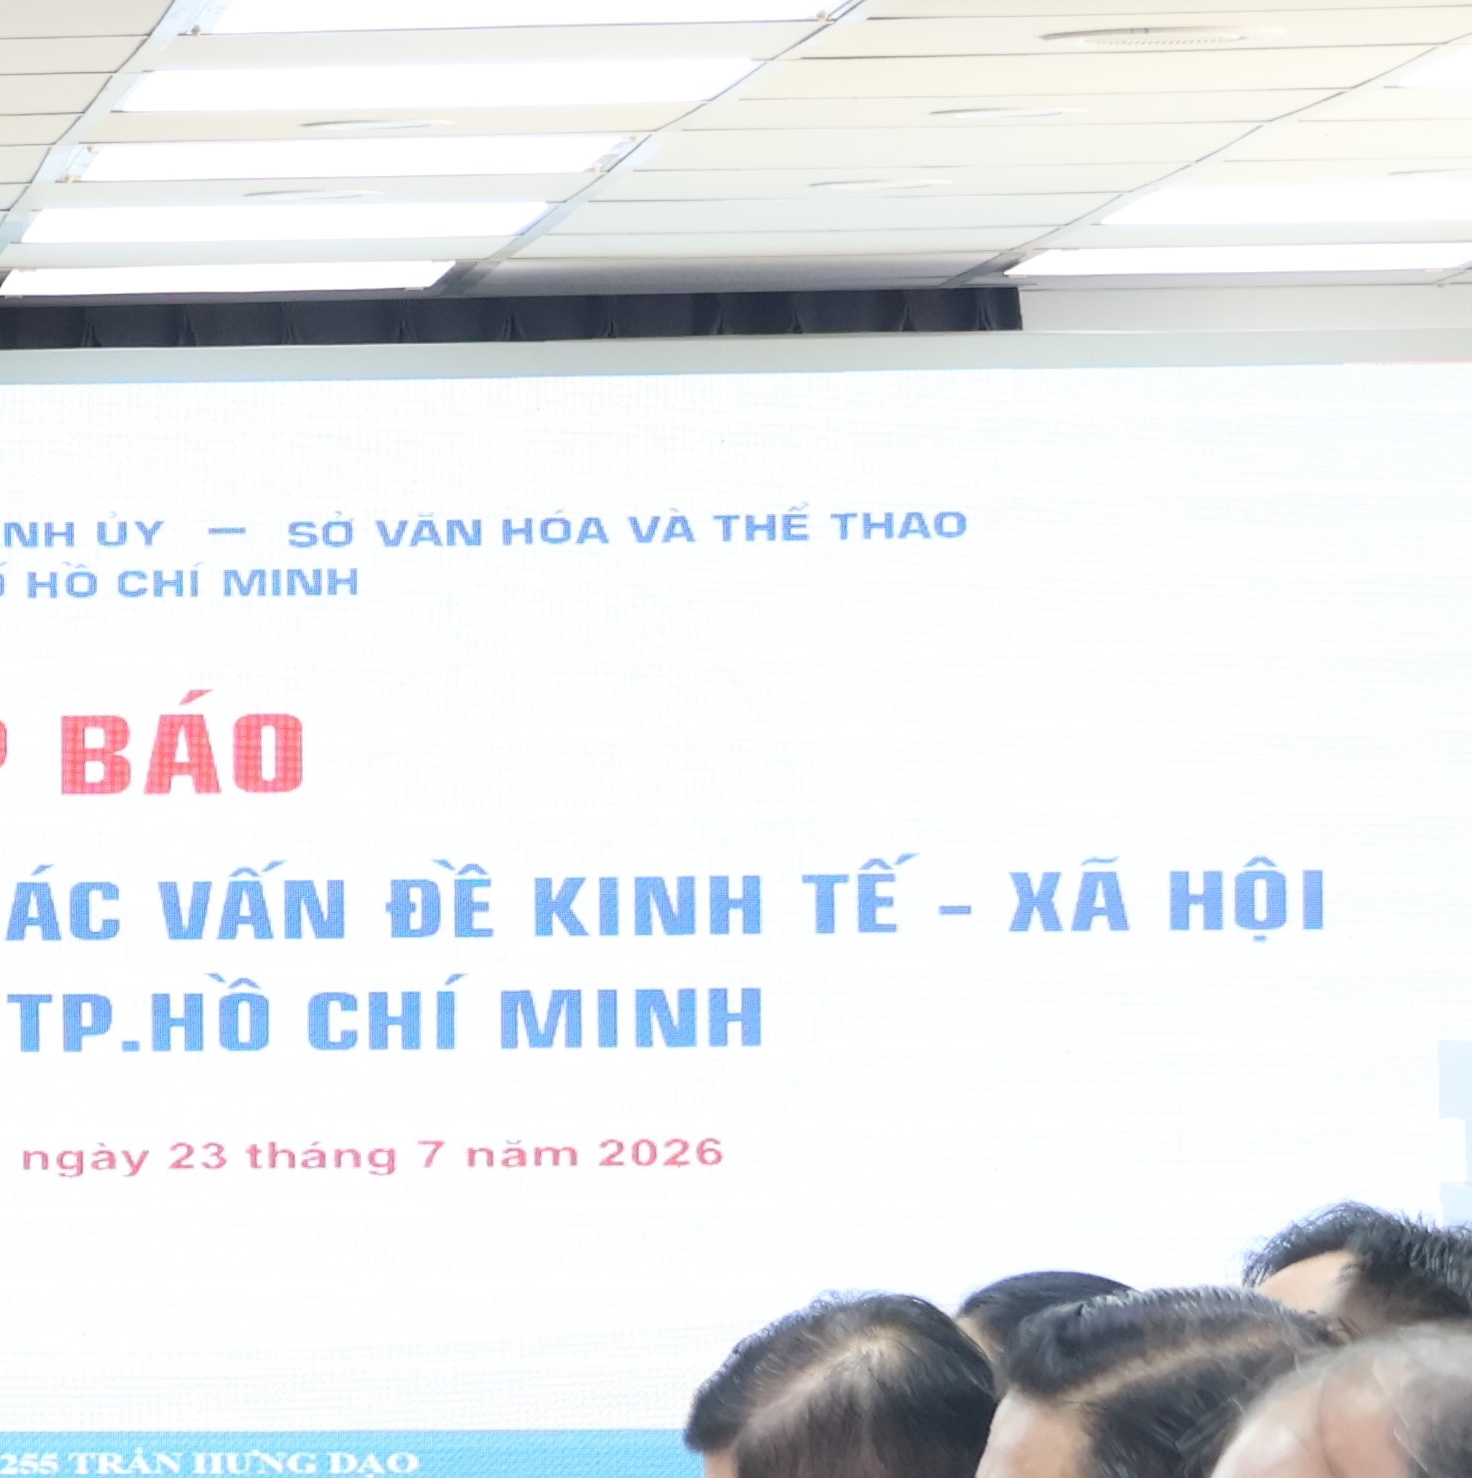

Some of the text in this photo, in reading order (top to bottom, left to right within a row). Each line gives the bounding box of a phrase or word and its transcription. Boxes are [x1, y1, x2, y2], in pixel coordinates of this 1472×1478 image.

[96, 511, 165, 548] ỦY
[288, 511, 355, 549] SỞ
[375, 512, 483, 548] VĂN
[502, 509, 610, 546] HÓA
[627, 508, 696, 545] VÀ
[713, 501, 810, 543] THỂ
[829, 511, 968, 541] THAO
[26, 561, 99, 600] HỒ
[117, 562, 204, 599] CHÍ
[223, 568, 359, 598] MINH
[60, 689, 304, 796] BÁO
[157, 860, 346, 941] VẤN
[385, 858, 495, 939] ĐỀ
[534, 874, 763, 938] KINH
[801, 853, 920, 935] TẾ
[1009, 857, 1131, 933] XÃ
[1169, 855, 1325, 943] HỘI
[7, 972, 271, 1053] TP.HỒ
[307, 973, 468, 1052] CHÍ
[500, 987, 762, 1050] MINH
[22, 1142, 149, 1179] ngày
[169, 1142, 229, 1170] 23
[247, 1142, 398, 1177] tháng
[418, 1139, 446, 1168] 7
[466, 1138, 580, 1168] năm
[599, 1138, 724, 1167] 2026
